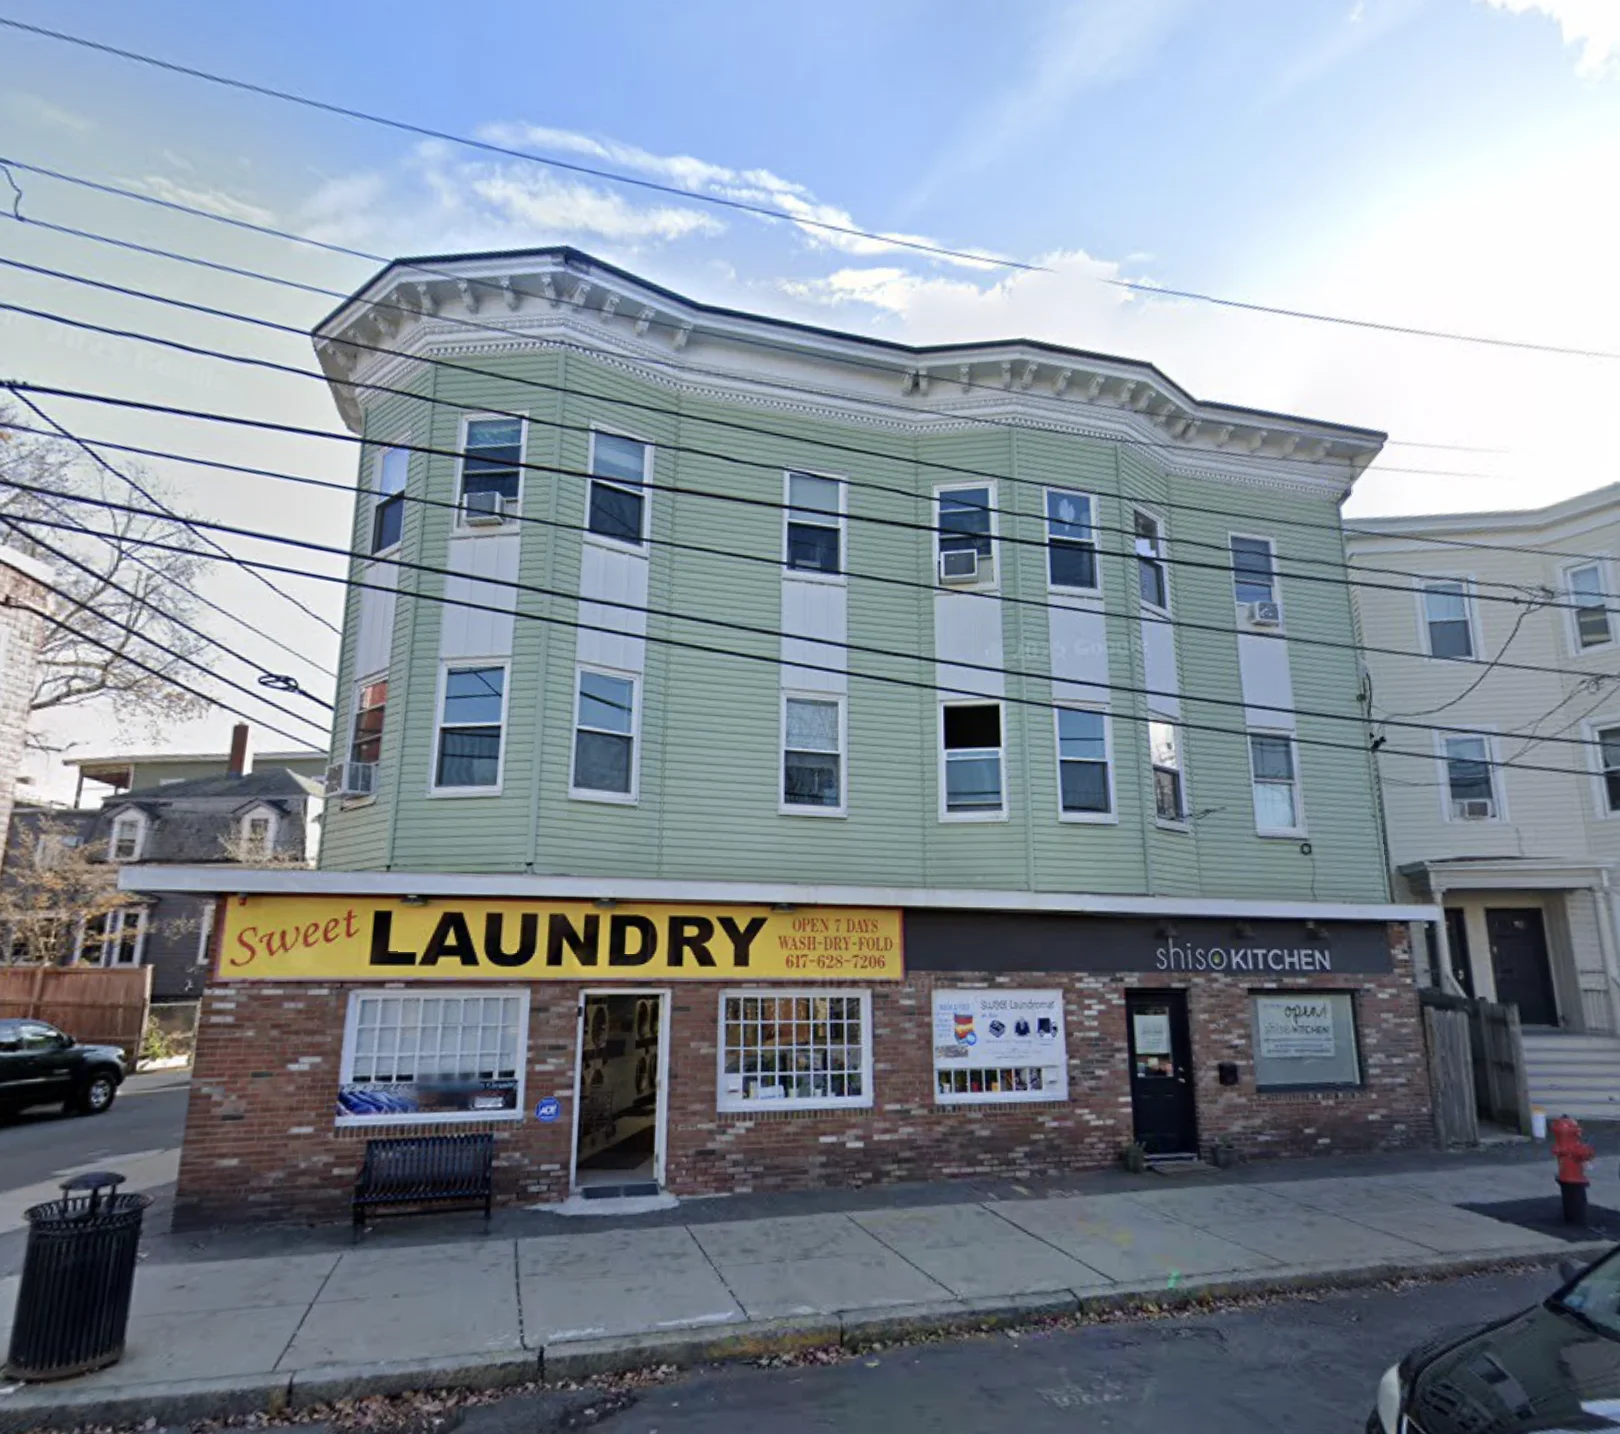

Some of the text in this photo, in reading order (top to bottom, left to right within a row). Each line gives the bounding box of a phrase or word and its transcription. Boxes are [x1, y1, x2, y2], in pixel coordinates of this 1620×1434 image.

[230, 908, 768, 968] Sweet LAUNDRY
[792, 918, 879, 934] OPEN 7 DAYS
[785, 954, 886, 969] 617-628-7206
[1156, 937, 1332, 970] shiso KITCHEN
